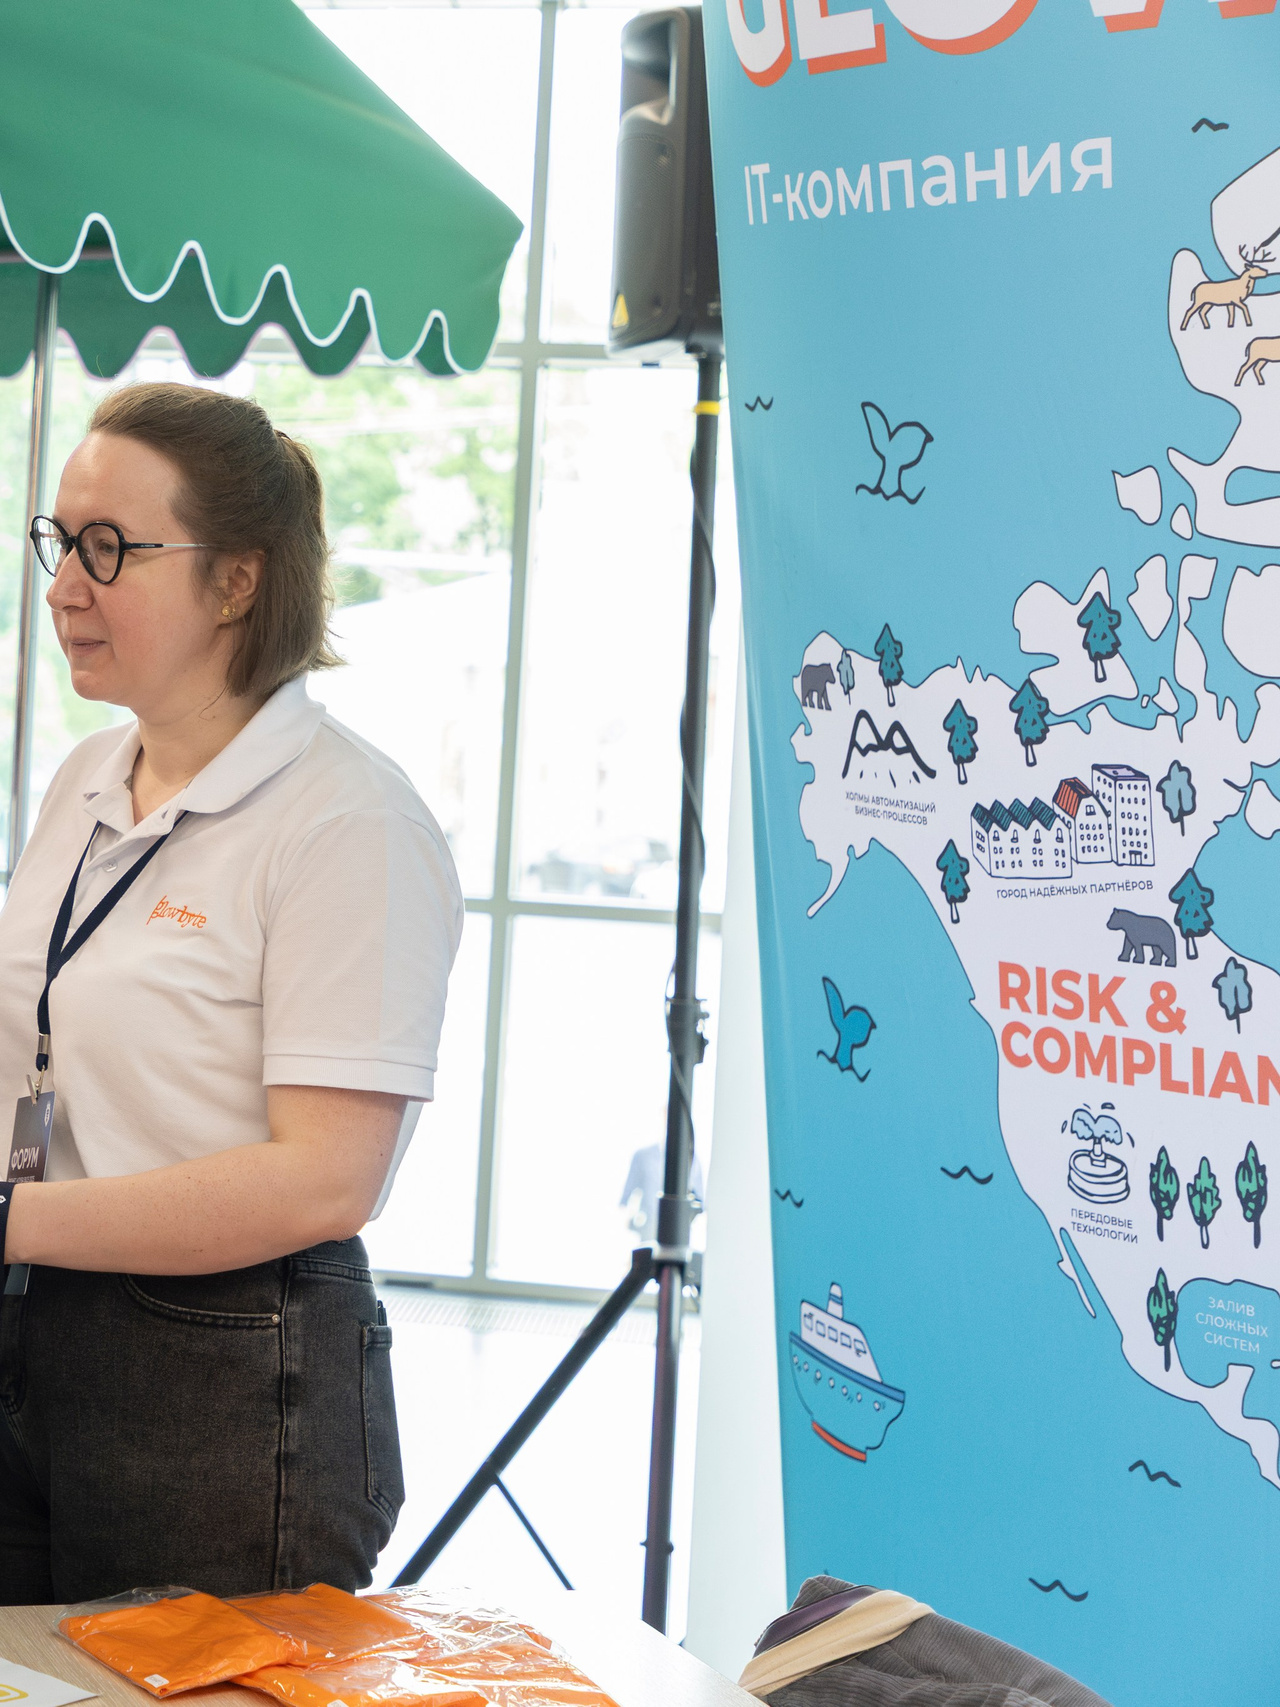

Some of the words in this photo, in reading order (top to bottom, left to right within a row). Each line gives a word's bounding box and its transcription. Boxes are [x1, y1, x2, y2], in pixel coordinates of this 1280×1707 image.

[744, 136, 1113, 225] IT-компания
[845, 790, 870, 804] ХОЛМЫ
[871, 796, 936, 814] АВТОМАТИЗАЦИЙ
[855, 805, 928, 826] БИЗНЕС-ПРОЦЕССОВ
[996, 888, 1028, 899] ГОРОД
[1029, 885, 1088, 898] НАДЁЖНЫХ
[1090, 880, 1154, 894] ПАРТНЁРОВ
[146, 895, 207, 929] glowbyte
[998, 960, 1129, 1028] RISK
[1145, 980, 1187, 1035] &
[11, 1146, 40, 1171] ФОРУМ
[1071, 1208, 1133, 1229] ПЕРЕДОВЫЕ
[1071, 1221, 1138, 1244] ТЕХНОЛОГИИ
[1208, 1296, 1256, 1317] ЗАЛИВ
[1195, 1312, 1269, 1338] СЛОЖНЫХ
[1204, 1331, 1260, 1354] СИСТЕМ
